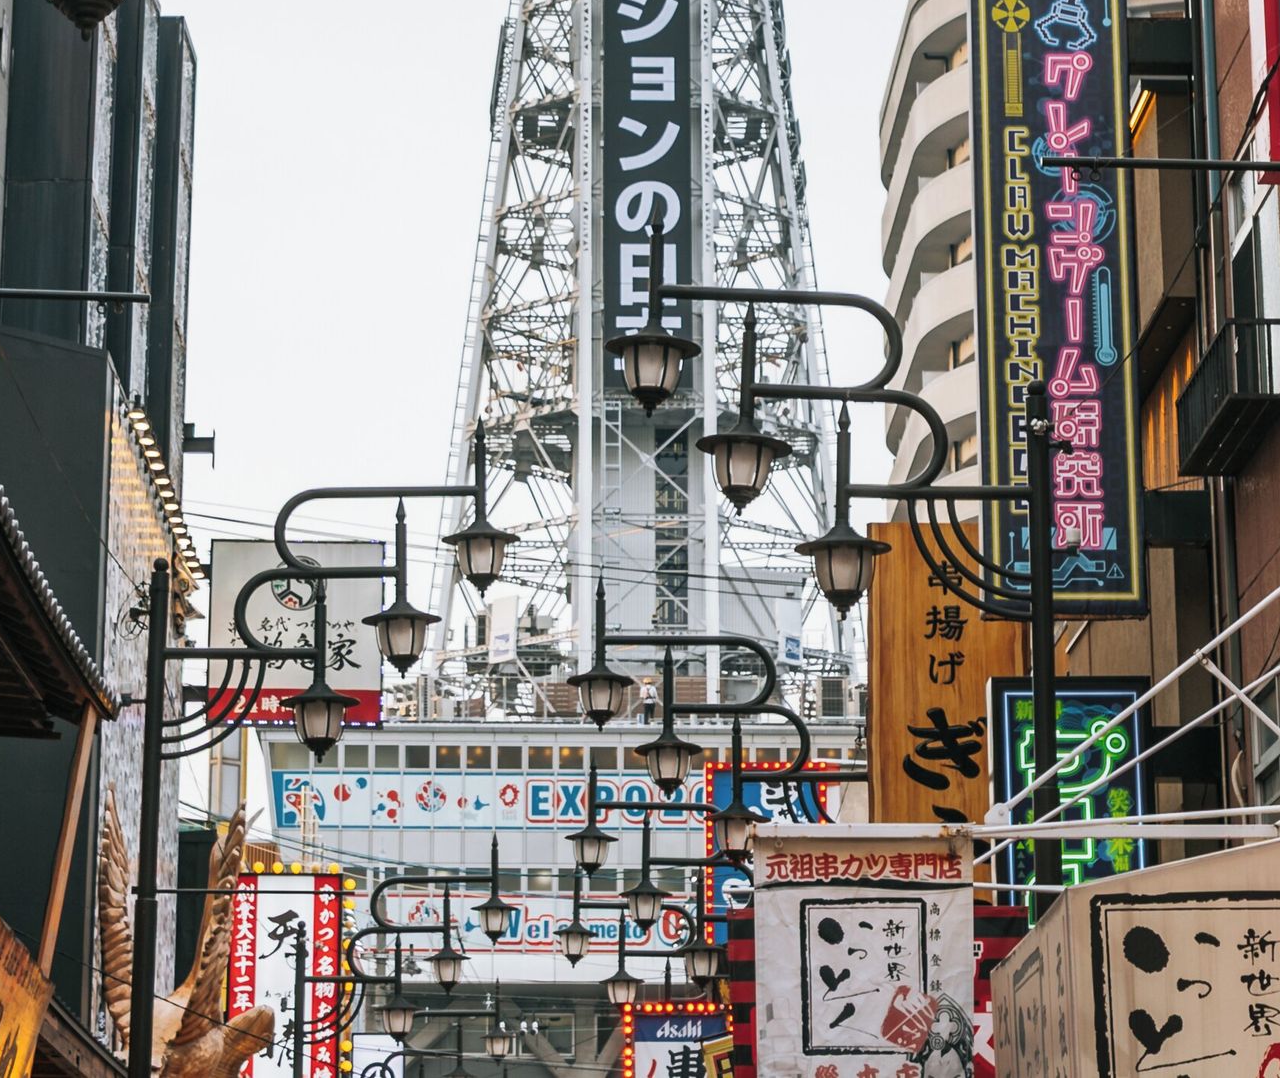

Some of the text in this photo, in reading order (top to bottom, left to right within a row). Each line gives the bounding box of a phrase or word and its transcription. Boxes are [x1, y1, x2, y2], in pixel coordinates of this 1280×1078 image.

[1004, 127, 1034, 240] CLAW
[924, 560, 968, 685] 串揚げ
[766, 853, 962, 880] 元祖串カツ専門店
[233, 883, 255, 1010] 創業大正十二年
[882, 920, 911, 982] 新世界
[928, 903, 942, 993] 商標登録
[656, 1020, 702, 1038] Asahi
